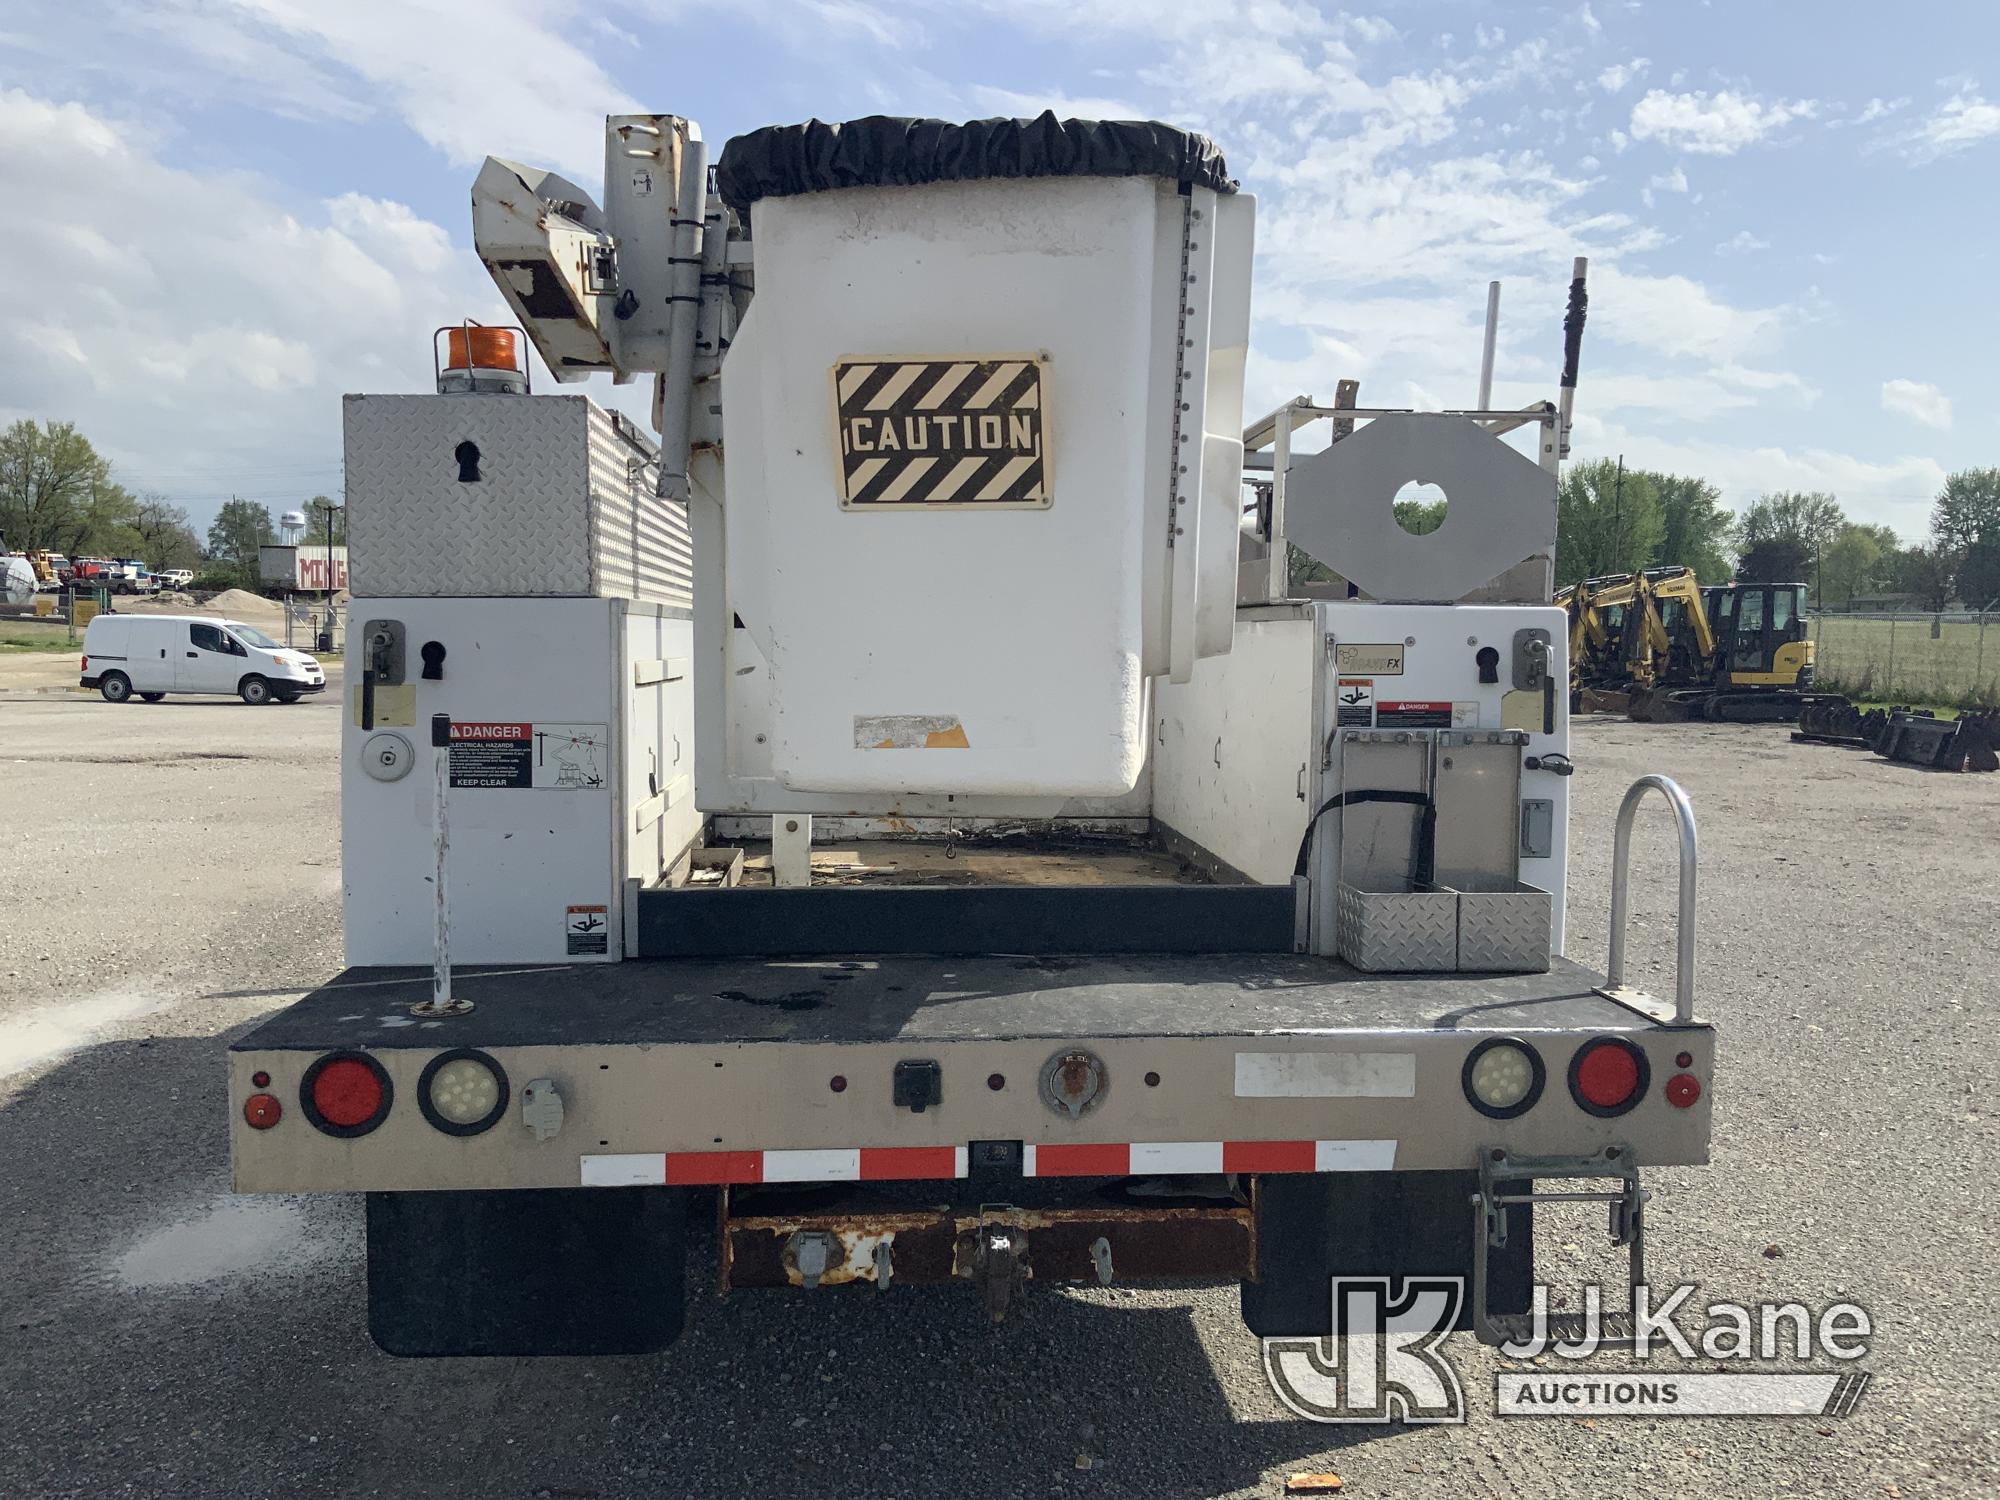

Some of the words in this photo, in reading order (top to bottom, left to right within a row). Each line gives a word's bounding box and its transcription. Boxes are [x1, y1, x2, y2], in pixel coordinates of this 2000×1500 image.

[851, 415, 1032, 451] CAUTION
[1405, 702, 1429, 710] DANGER
[463, 726, 521, 738] DANGER
